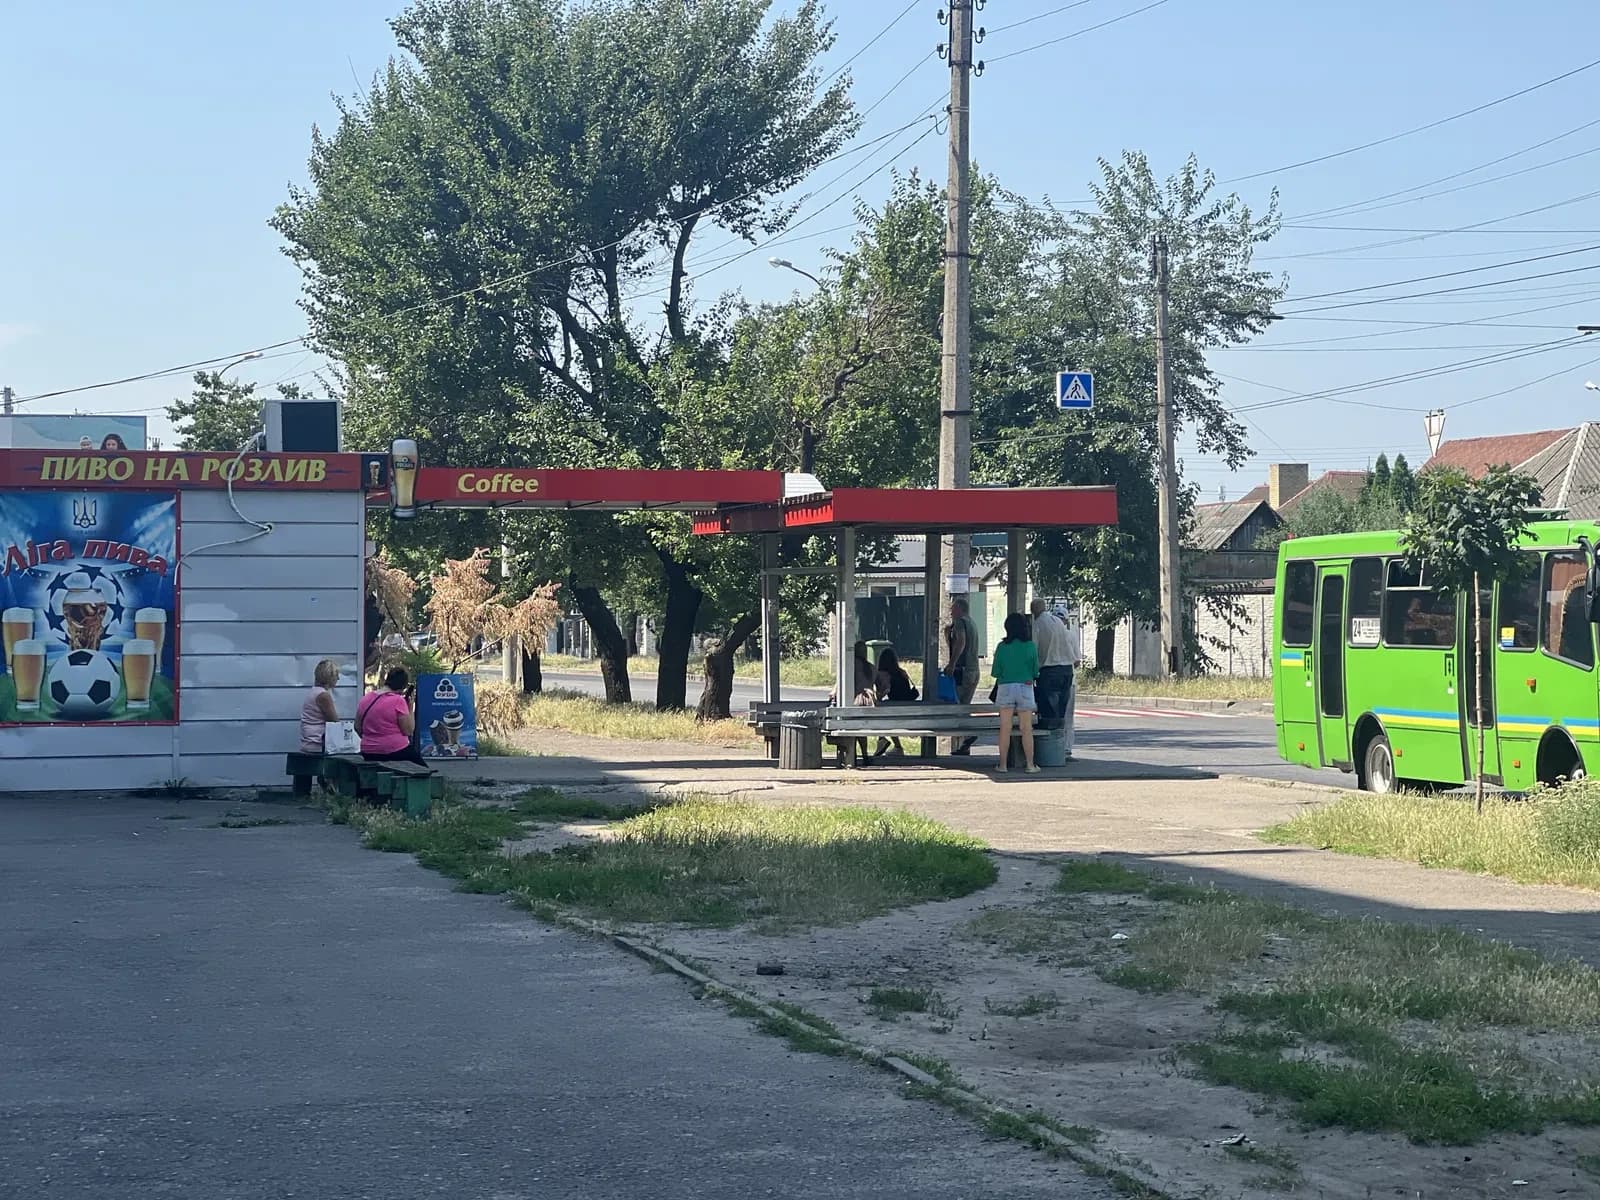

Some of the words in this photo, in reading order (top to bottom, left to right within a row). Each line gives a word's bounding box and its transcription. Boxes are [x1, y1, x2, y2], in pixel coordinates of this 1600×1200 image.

[40, 457, 135, 481] ПИВО
[143, 458, 190, 481] НА
[200, 458, 327, 482] РОЗЛИВ
[457, 473, 539, 493] Coffee
[1, 539, 75, 577] Ліга
[82, 539, 168, 577] пива
